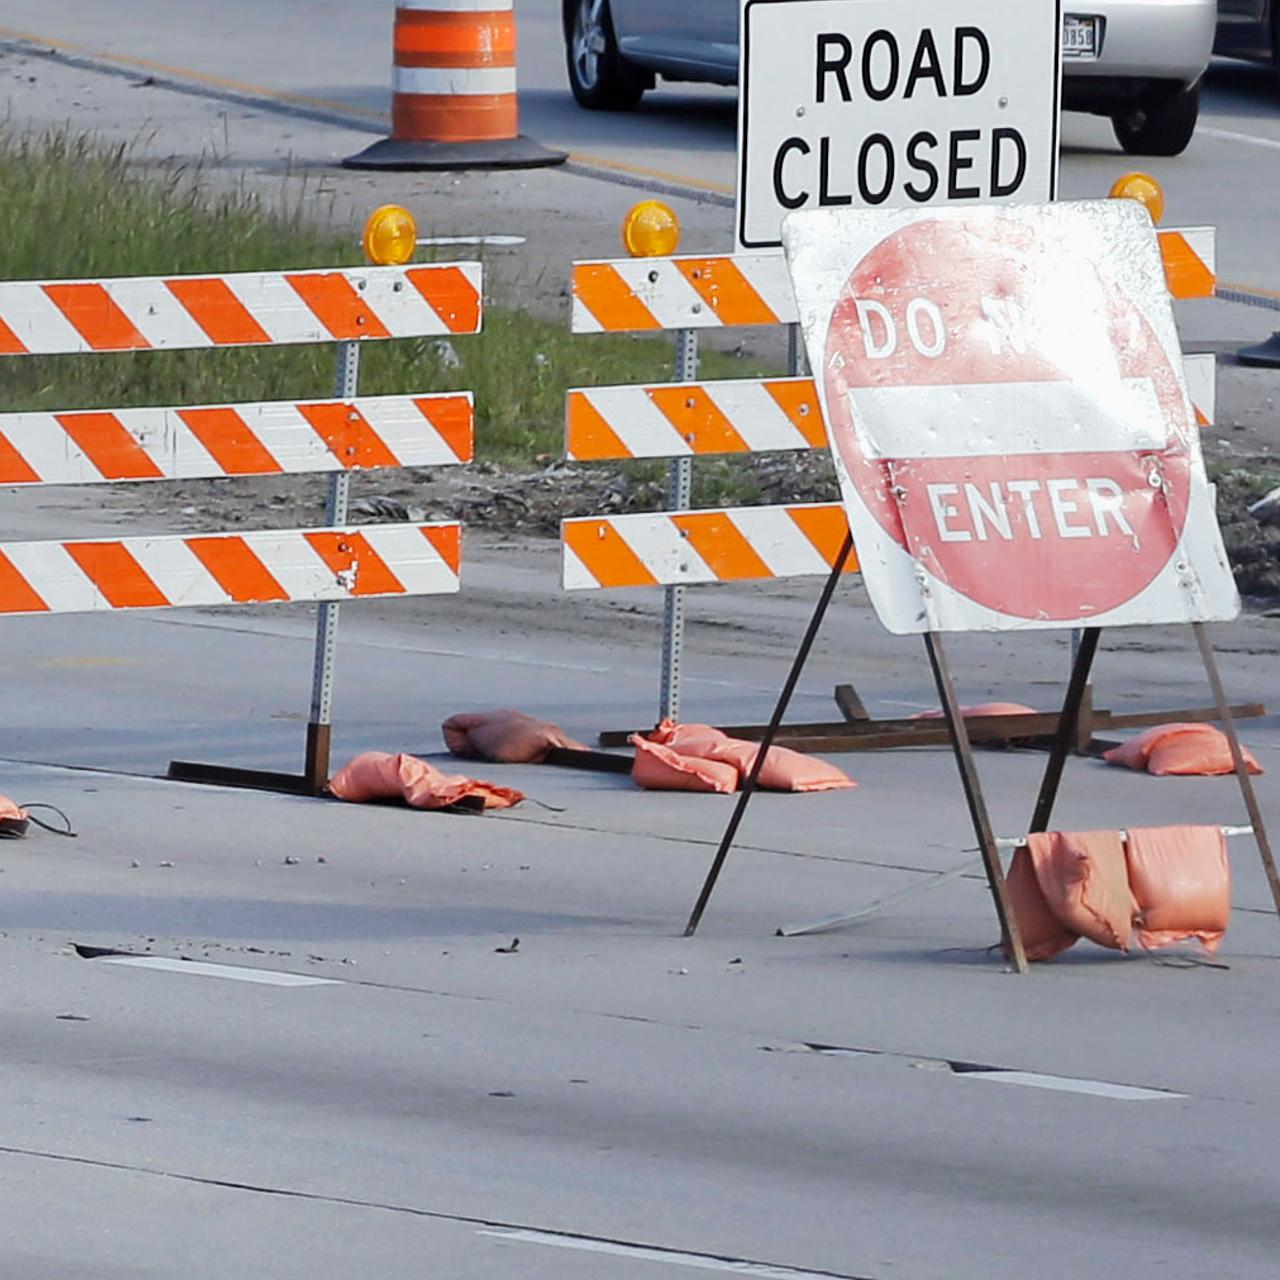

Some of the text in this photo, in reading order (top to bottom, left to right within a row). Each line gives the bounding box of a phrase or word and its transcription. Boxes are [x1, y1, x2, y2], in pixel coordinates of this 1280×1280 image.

[816, 26, 991, 103] ROAD
[773, 127, 1027, 209] CLOSED
[856, 297, 948, 359] DO
[927, 477, 1134, 542] ENTER
